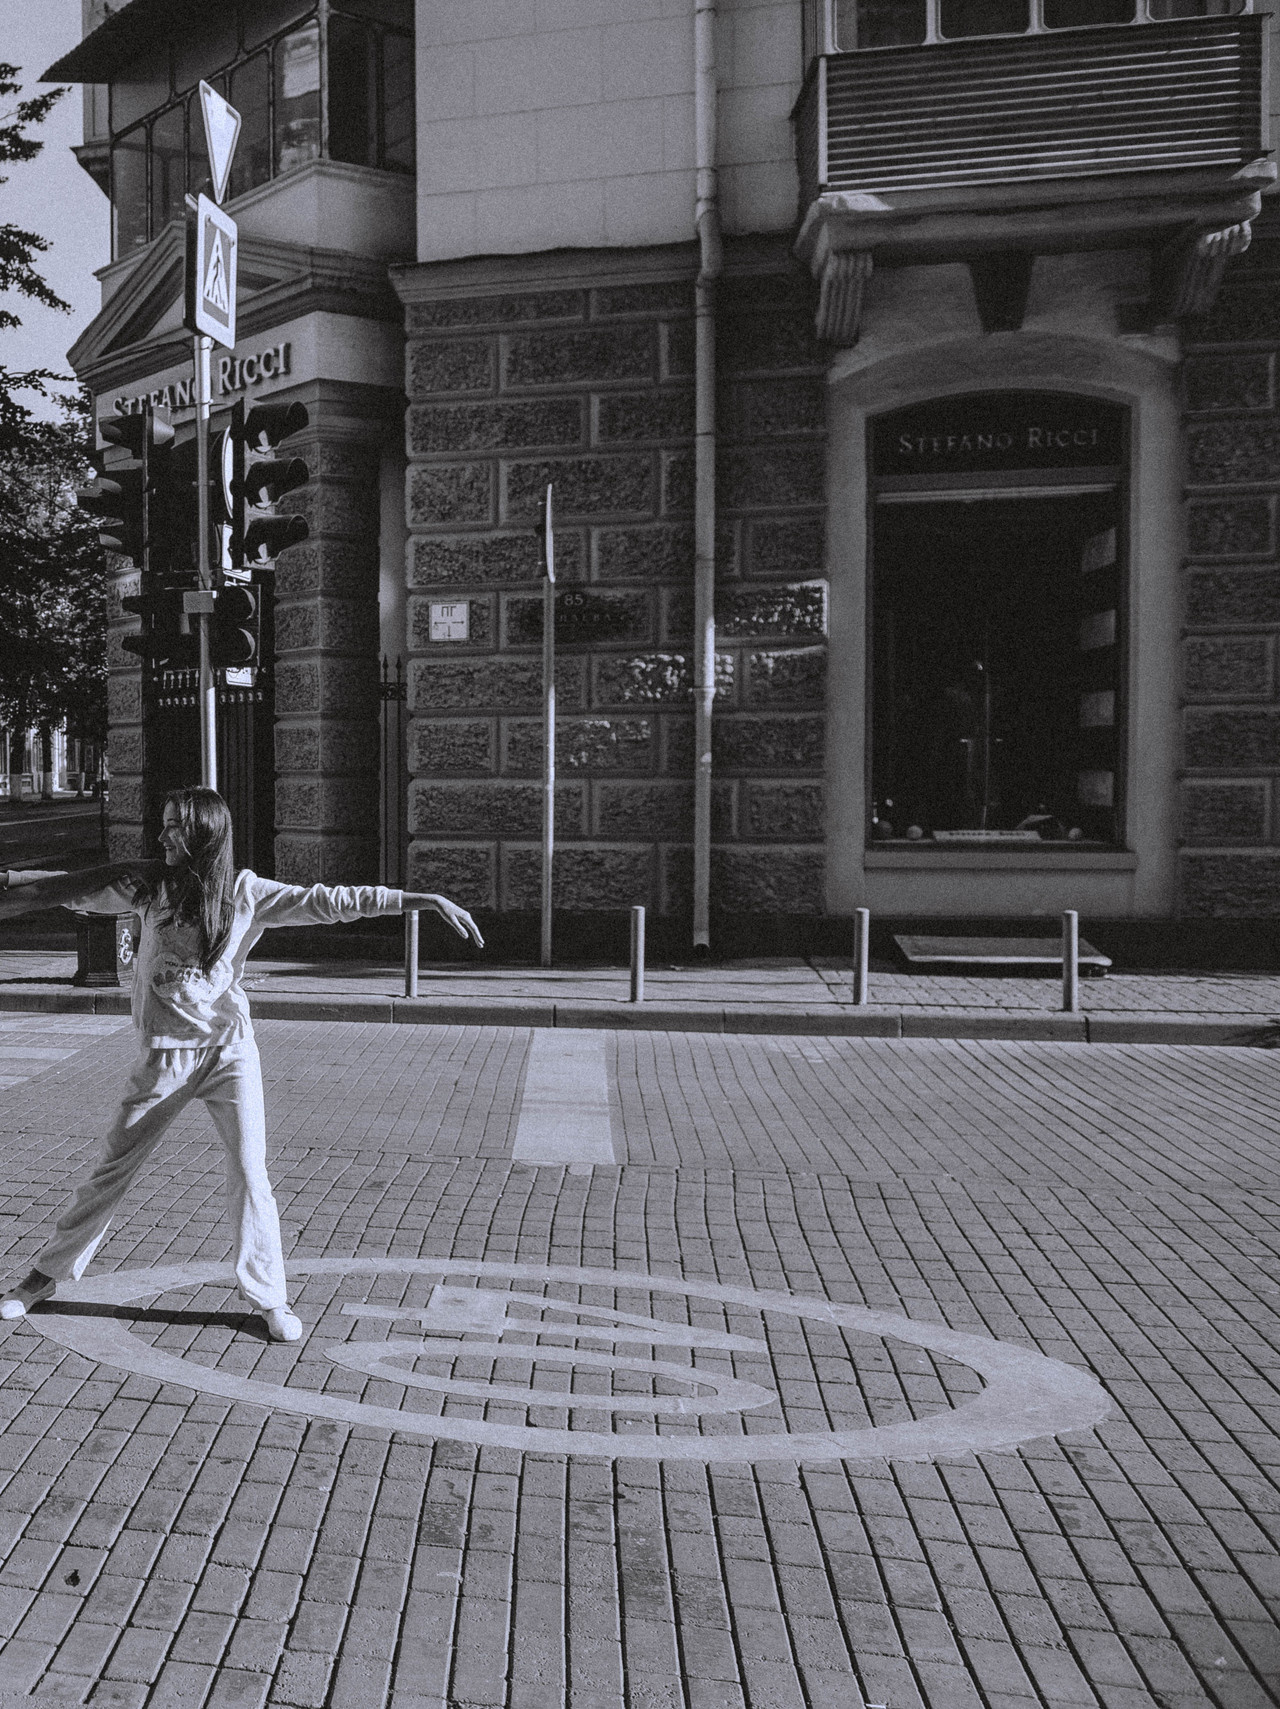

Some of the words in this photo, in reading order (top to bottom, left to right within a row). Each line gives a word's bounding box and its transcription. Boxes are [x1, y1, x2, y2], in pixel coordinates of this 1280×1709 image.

[217, 342, 290, 396] RICCI
[898, 432, 1013, 455] STEFANO
[1027, 426, 1099, 449] RICCI
[441, 605, 457, 617] ПГ
[563, 594, 584, 607] 85
